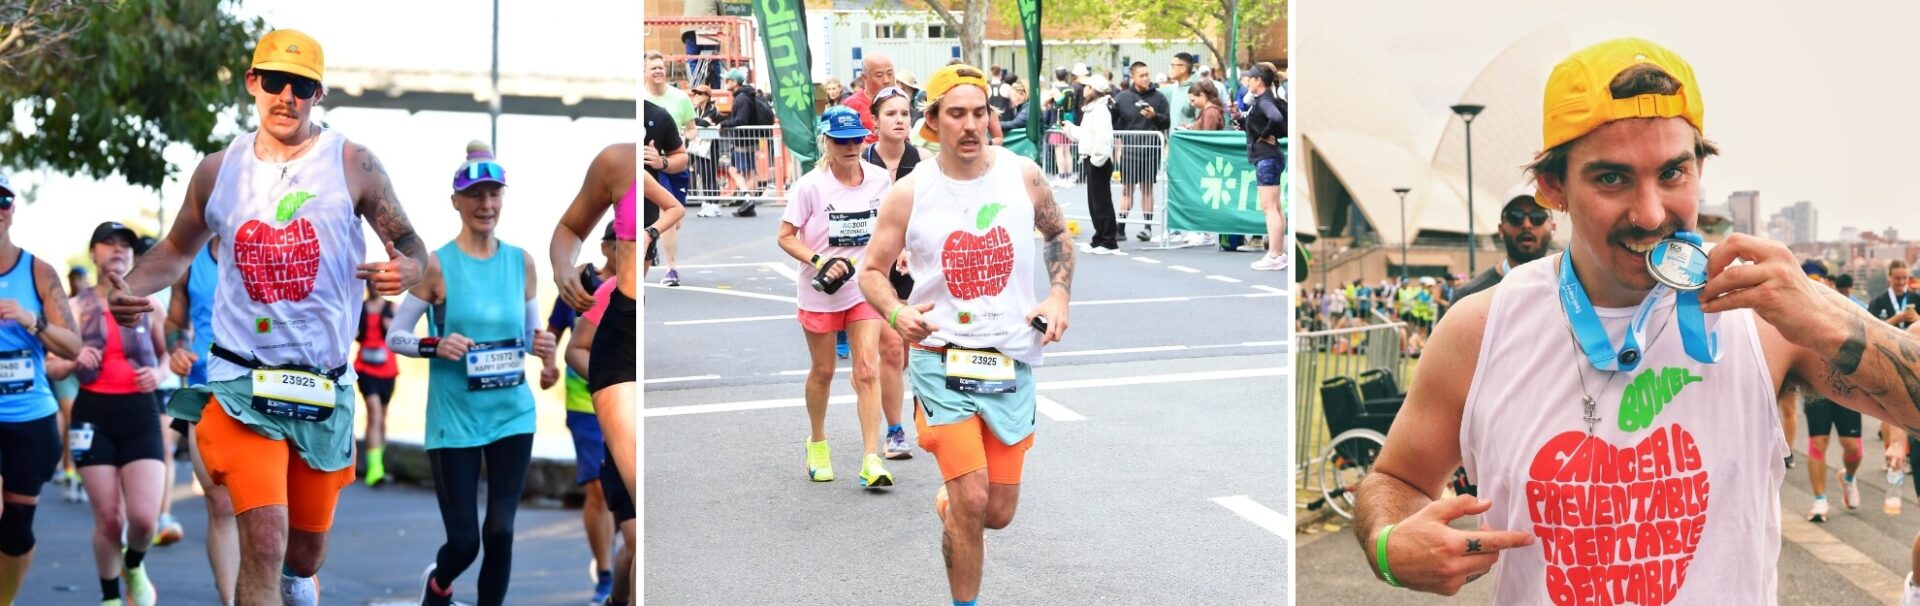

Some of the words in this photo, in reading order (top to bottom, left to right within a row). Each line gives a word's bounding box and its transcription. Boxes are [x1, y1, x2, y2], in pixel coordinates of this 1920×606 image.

[723, 4, 740, 14] College
[235, 219, 301, 245] CANCER
[301, 217, 316, 241] IS
[943, 226, 999, 251] CANCER
[998, 225, 1010, 244] IS
[233, 239, 320, 265] PREVENTABLE
[941, 242, 1014, 269] PREVENTABLE
[236, 258, 320, 282] TREATABLE
[943, 260, 1014, 283] TREATABLE
[243, 278, 315, 304] BEATABLE
[947, 275, 1010, 300] BEATABLE
[1618, 367, 1703, 432] BOWEL
[1529, 427, 1671, 484] CANCER
[1671, 423, 1702, 472] IS
[1526, 471, 1710, 527] PREVENTABLE
[1533, 514, 1706, 566] TREATABLE
[1546, 554, 1694, 606] BEATABLE
